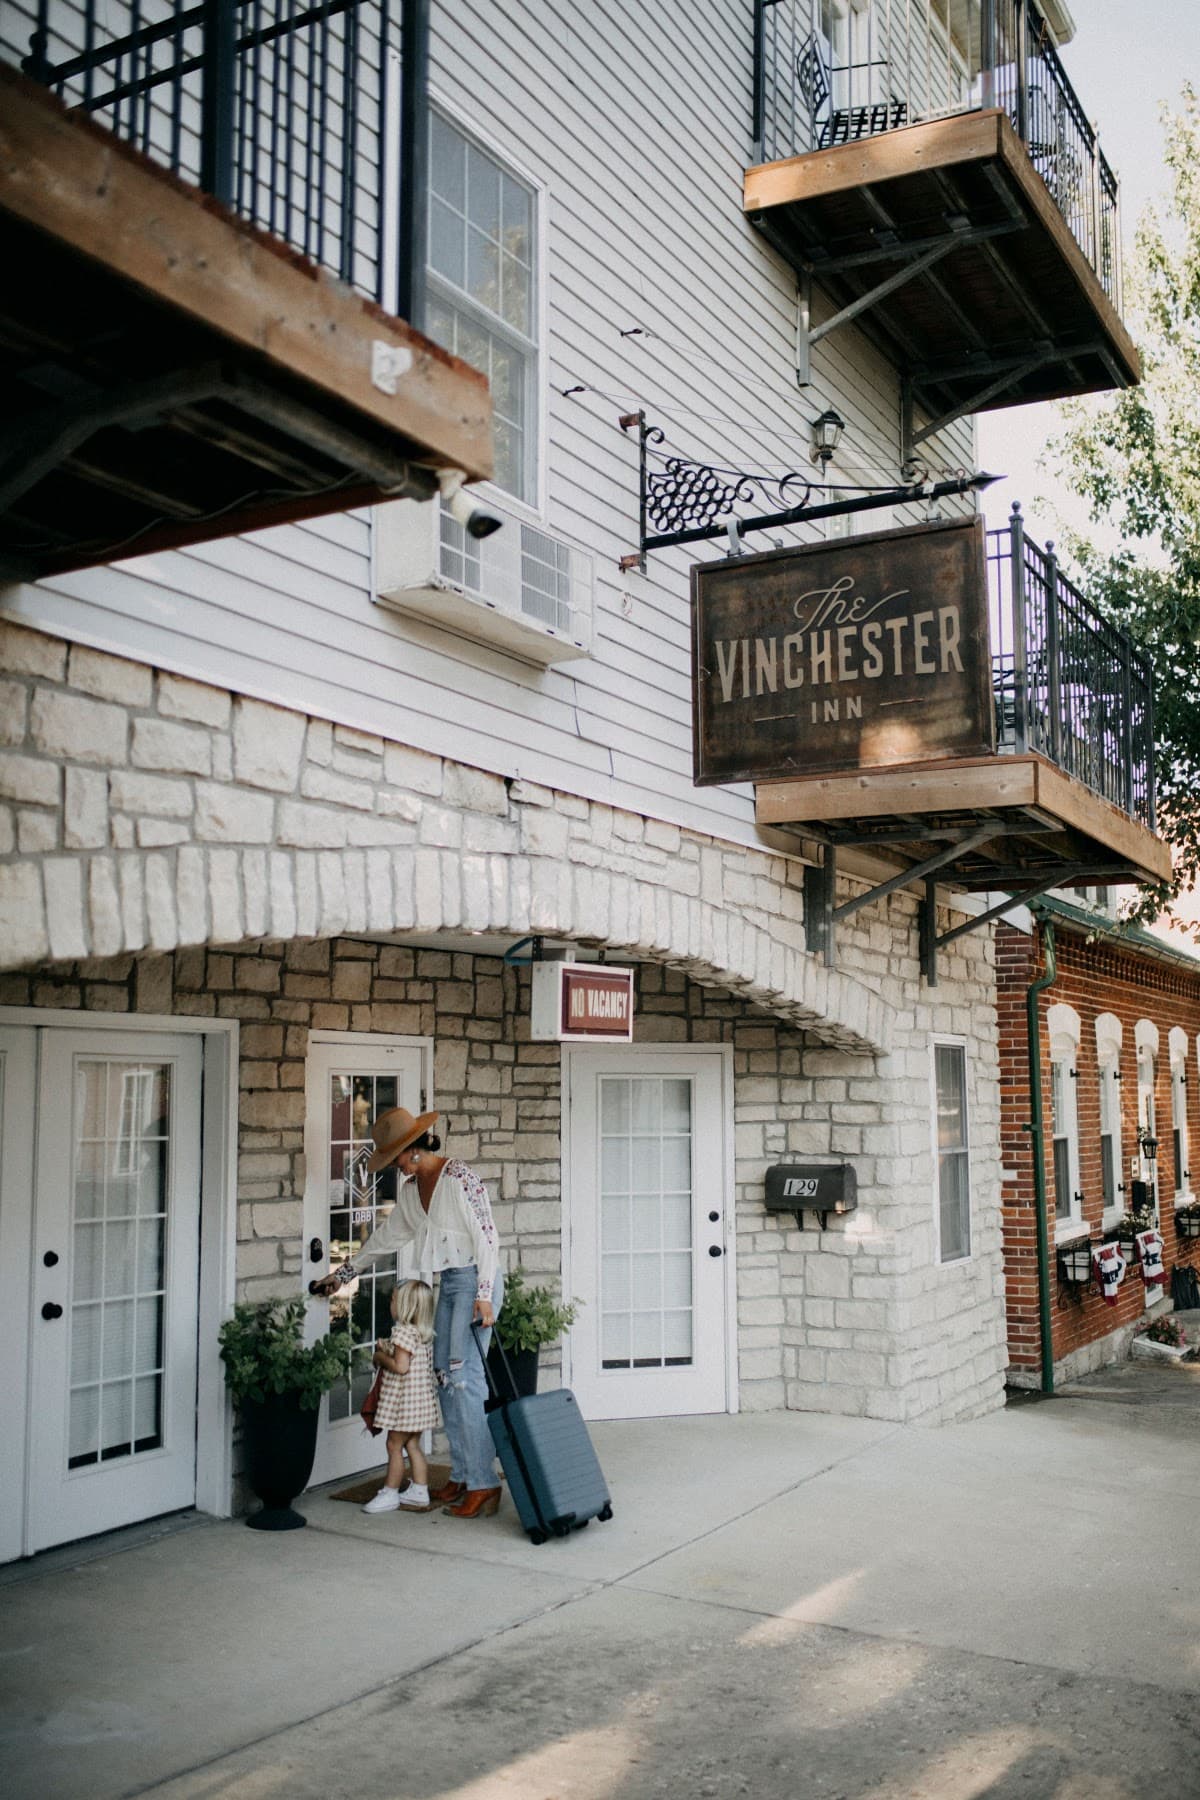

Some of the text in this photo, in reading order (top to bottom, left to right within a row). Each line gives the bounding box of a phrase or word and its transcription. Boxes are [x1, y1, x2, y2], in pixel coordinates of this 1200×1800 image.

[793, 576, 909, 635] The
[715, 605, 965, 703] VINCHESTER
[811, 696, 863, 724] INN
[571, 987, 628, 1019] NO VACANCY
[787, 1179, 817, 1195] 129
